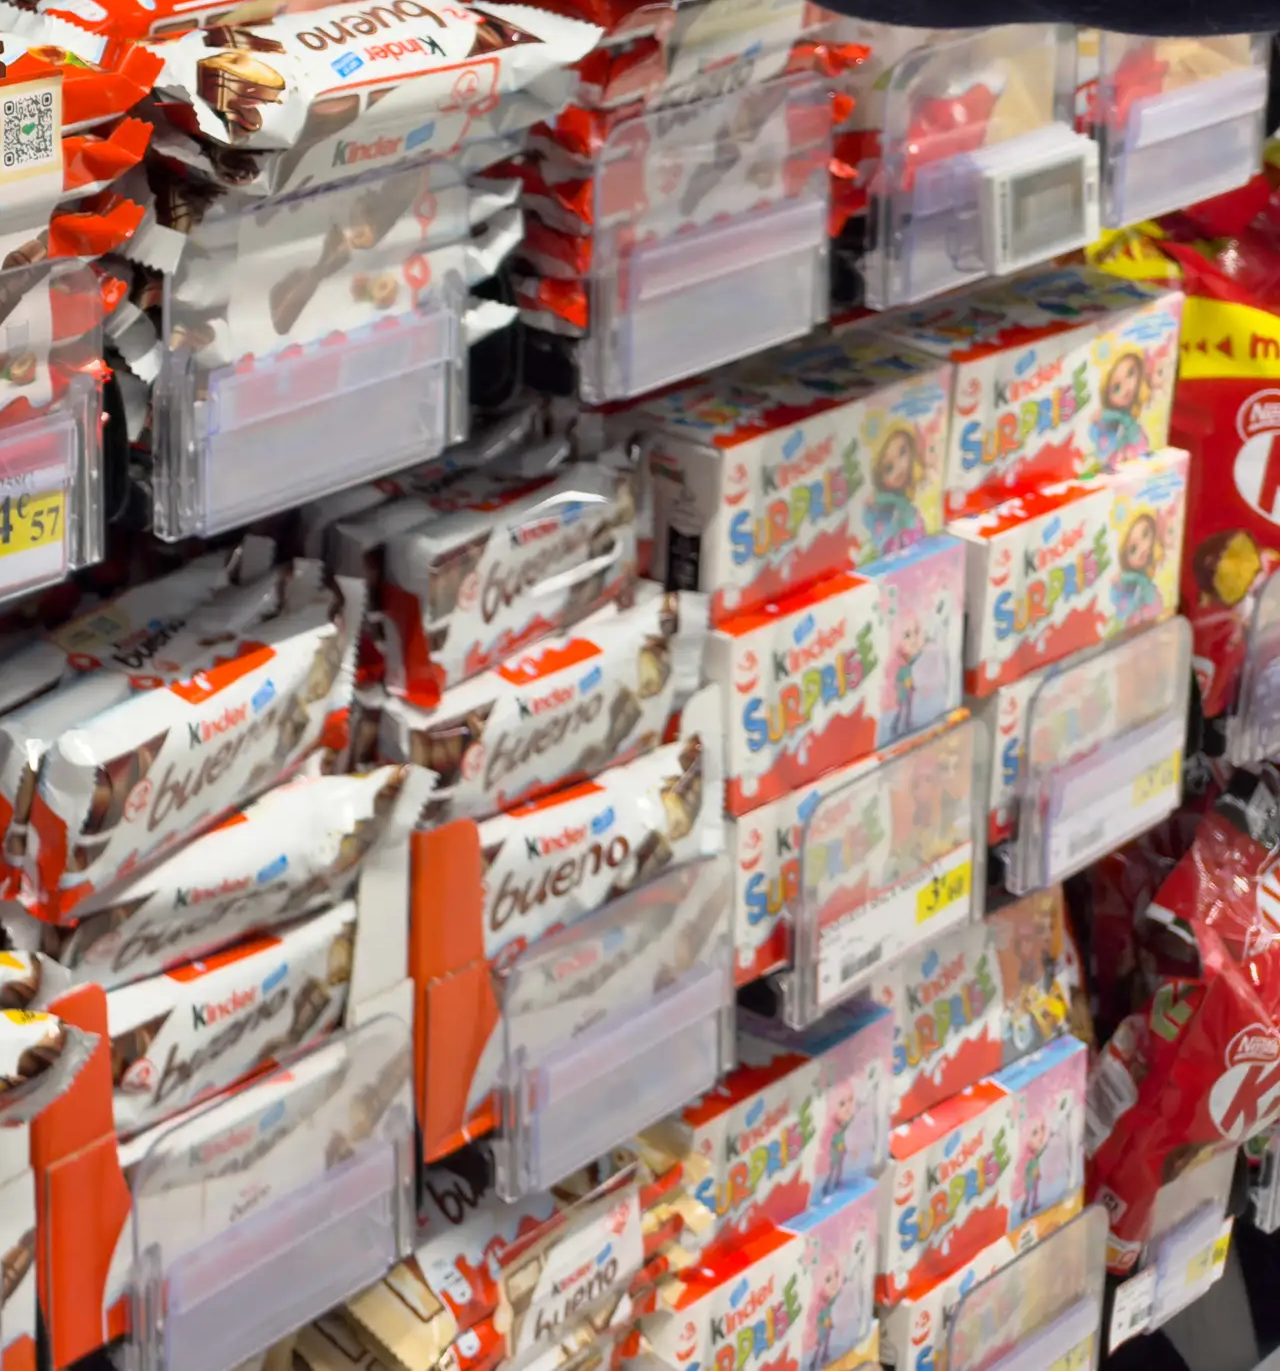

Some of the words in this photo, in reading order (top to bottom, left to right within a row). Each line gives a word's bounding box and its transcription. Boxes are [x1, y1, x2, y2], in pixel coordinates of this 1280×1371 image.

[362, 34, 448, 62] Kinder
[994, 355, 1064, 410] Kinder
[959, 360, 1092, 470] SURPRISE
[762, 436, 834, 494] Kinder
[728, 436, 863, 565] SURPRISE
[1024, 520, 1087, 577] Kinder
[992, 524, 1109, 640] SURPRISE
[772, 619, 846, 681] Kinder
[741, 622, 878, 752] SURPRISE
[187, 701, 250, 750] Kinder
[525, 818, 588, 861] Kinder
[489, 832, 632, 933] bueno
[192, 985, 258, 1030] Kinder
